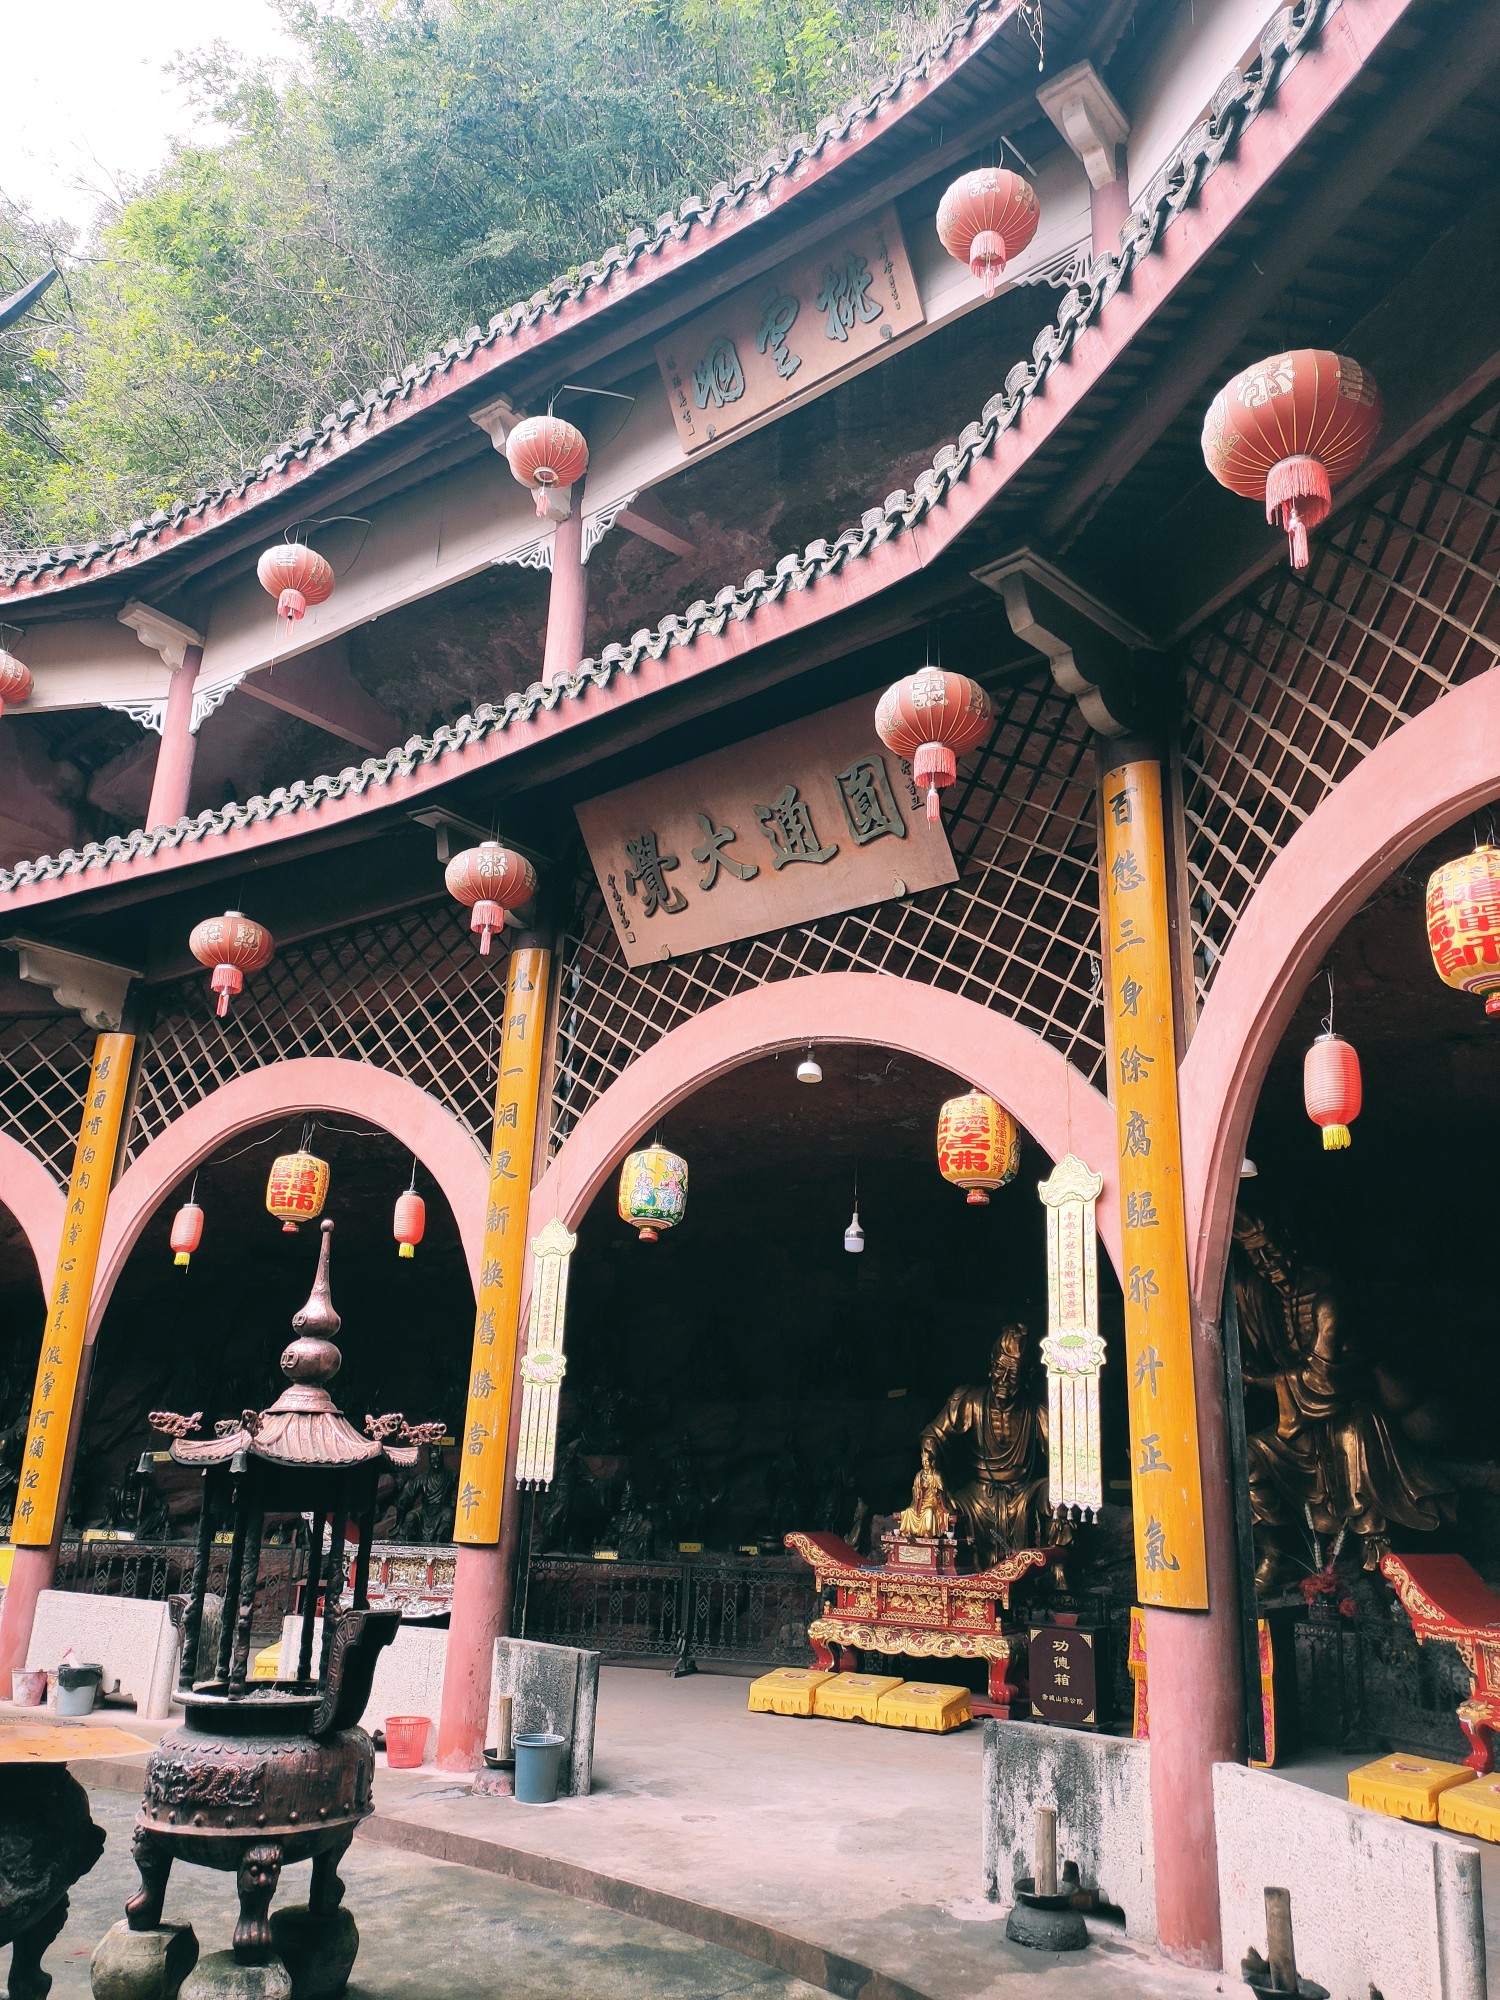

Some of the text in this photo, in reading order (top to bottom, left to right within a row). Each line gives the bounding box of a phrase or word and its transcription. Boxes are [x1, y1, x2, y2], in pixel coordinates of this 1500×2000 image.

[624, 754, 907, 917] 圓通大覺
[1052, 1640, 1071, 1687] 功德箱
